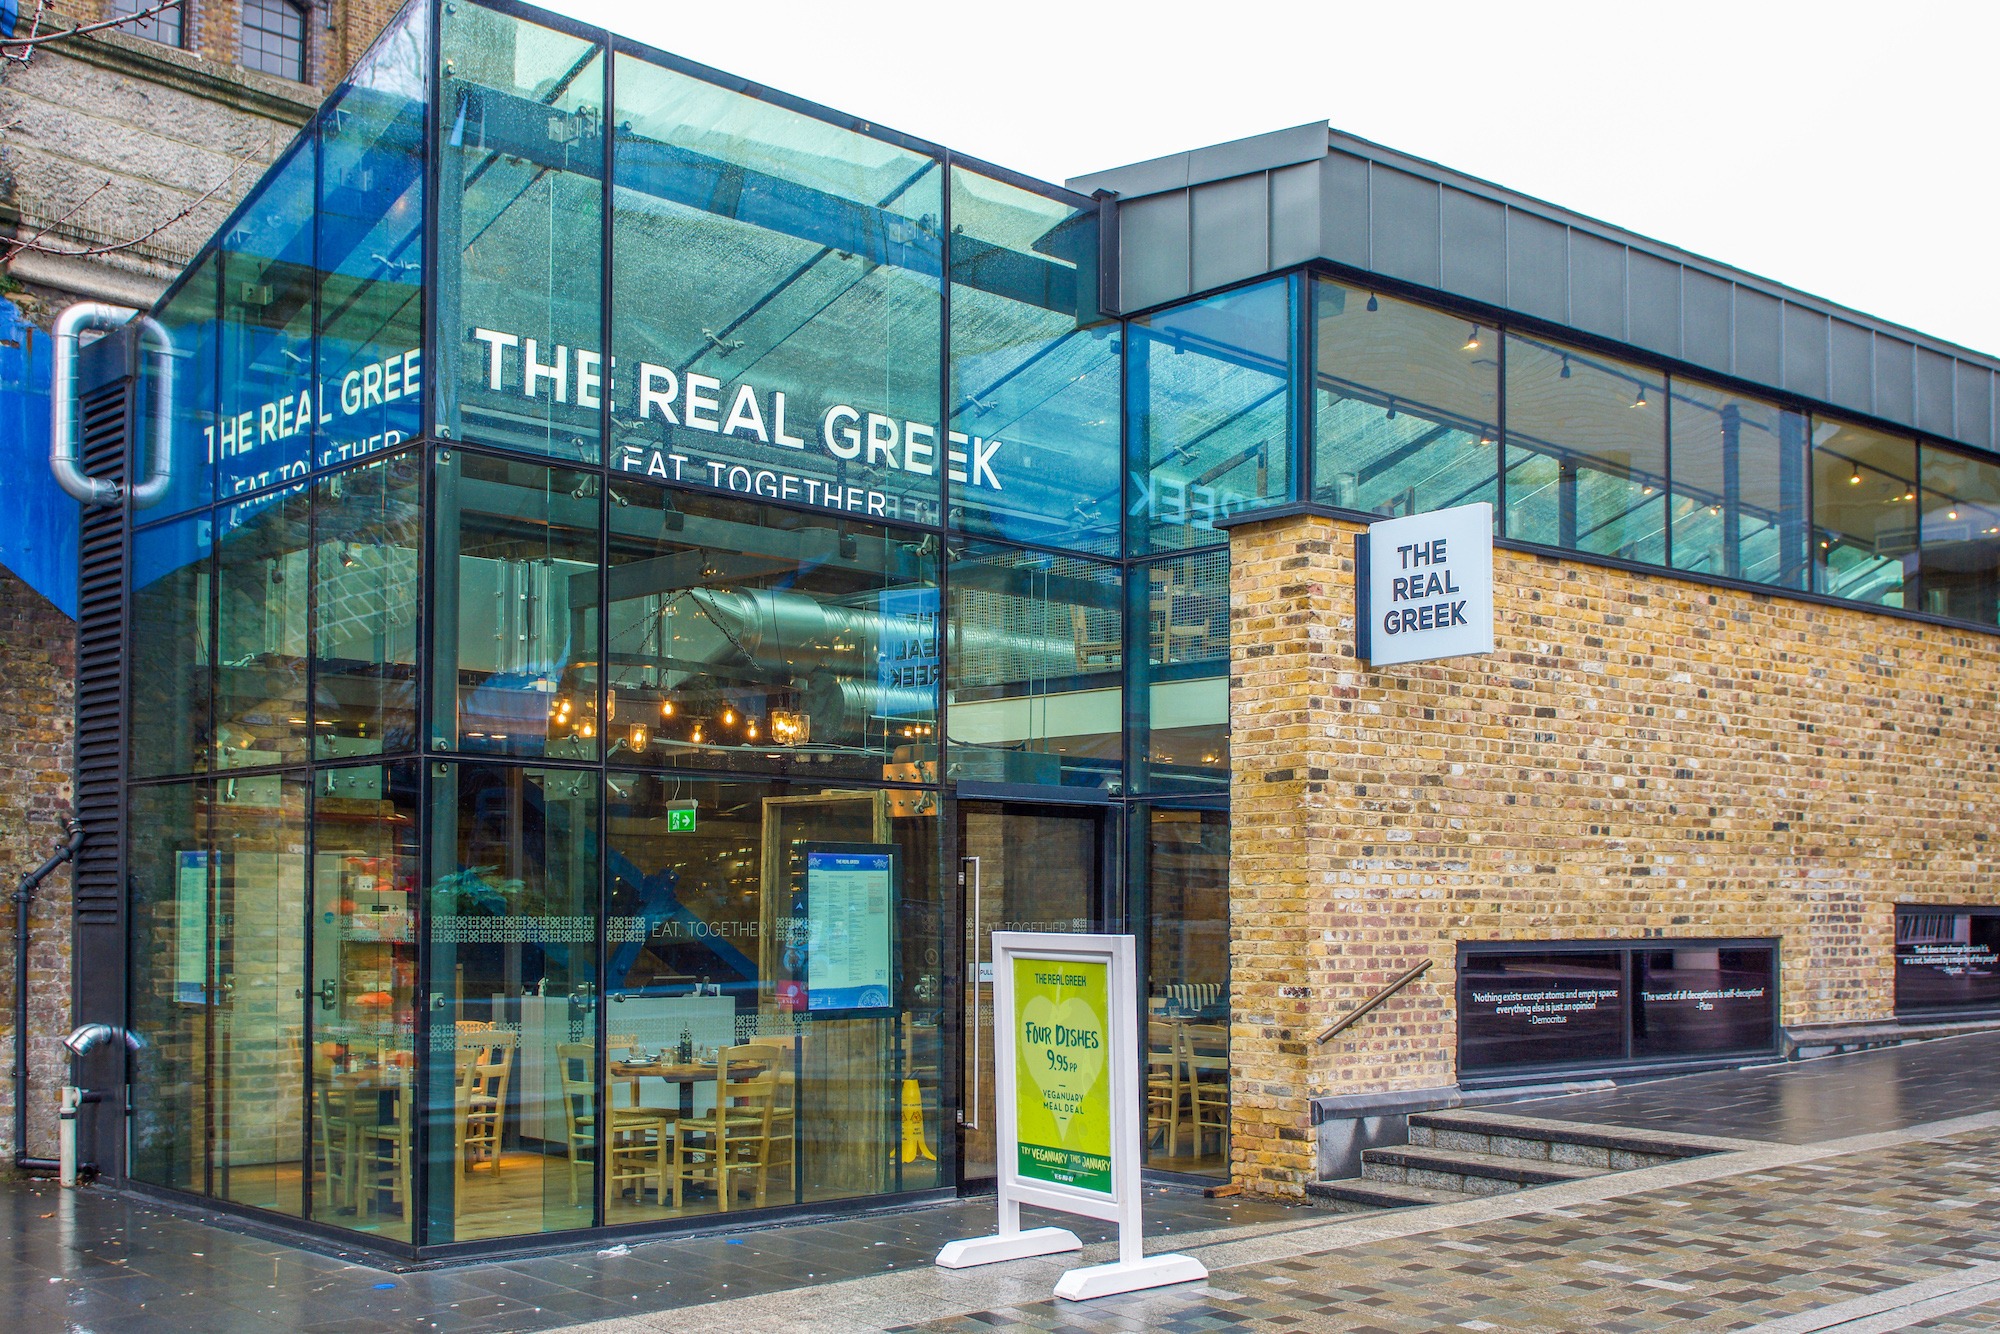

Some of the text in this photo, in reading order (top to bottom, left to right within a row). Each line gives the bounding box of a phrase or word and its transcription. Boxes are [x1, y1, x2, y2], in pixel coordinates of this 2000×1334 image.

[203, 410, 253, 465] THE
[260, 375, 333, 446] REAL
[474, 327, 1004, 490] THE REAL GREEK
[279, 429, 406, 492] TOETHER
[706, 461, 887, 517] TOGETHER
[1397, 538, 1447, 569] THE
[1392, 569, 1460, 602] REAL
[1383, 600, 1468, 635] GREEK
[651, 920, 770, 938] EAT. TOGETHER
[1004, 920, 1067, 934] TOGETHER
[1035, 973, 1087, 987] THE REAL GREEK
[1503, 991, 1522, 1001] exists
[1522, 991, 1545, 1003] except
[1544, 990, 1565, 1000] atoms
[1565, 988, 1578, 999] and
[1578, 989, 1598, 1002] empty
[1655, 991, 1673, 1001] worst
[1672, 990, 1680, 1000] of
[1687, 989, 1718, 1002] deceptions
[1718, 989, 1723, 999] is
[1496, 1003, 1533, 1016] everything
[1532, 1003, 1545, 1013] else
[1545, 1002, 1551, 1012] is
[1550, 1002, 1564, 1015] just
[1563, 1003, 1572, 1011] an
[1025, 1021, 1099, 1049] FOUR DISHES
[1046, 1049, 1069, 1072] 9.95
[1042, 1089, 1084, 1103] VEGANUARY
[1043, 1101, 1085, 1115] MEAL DEAL
[1021, 1145, 1111, 1172] TRY VEGANUARY THIS JANUARY
